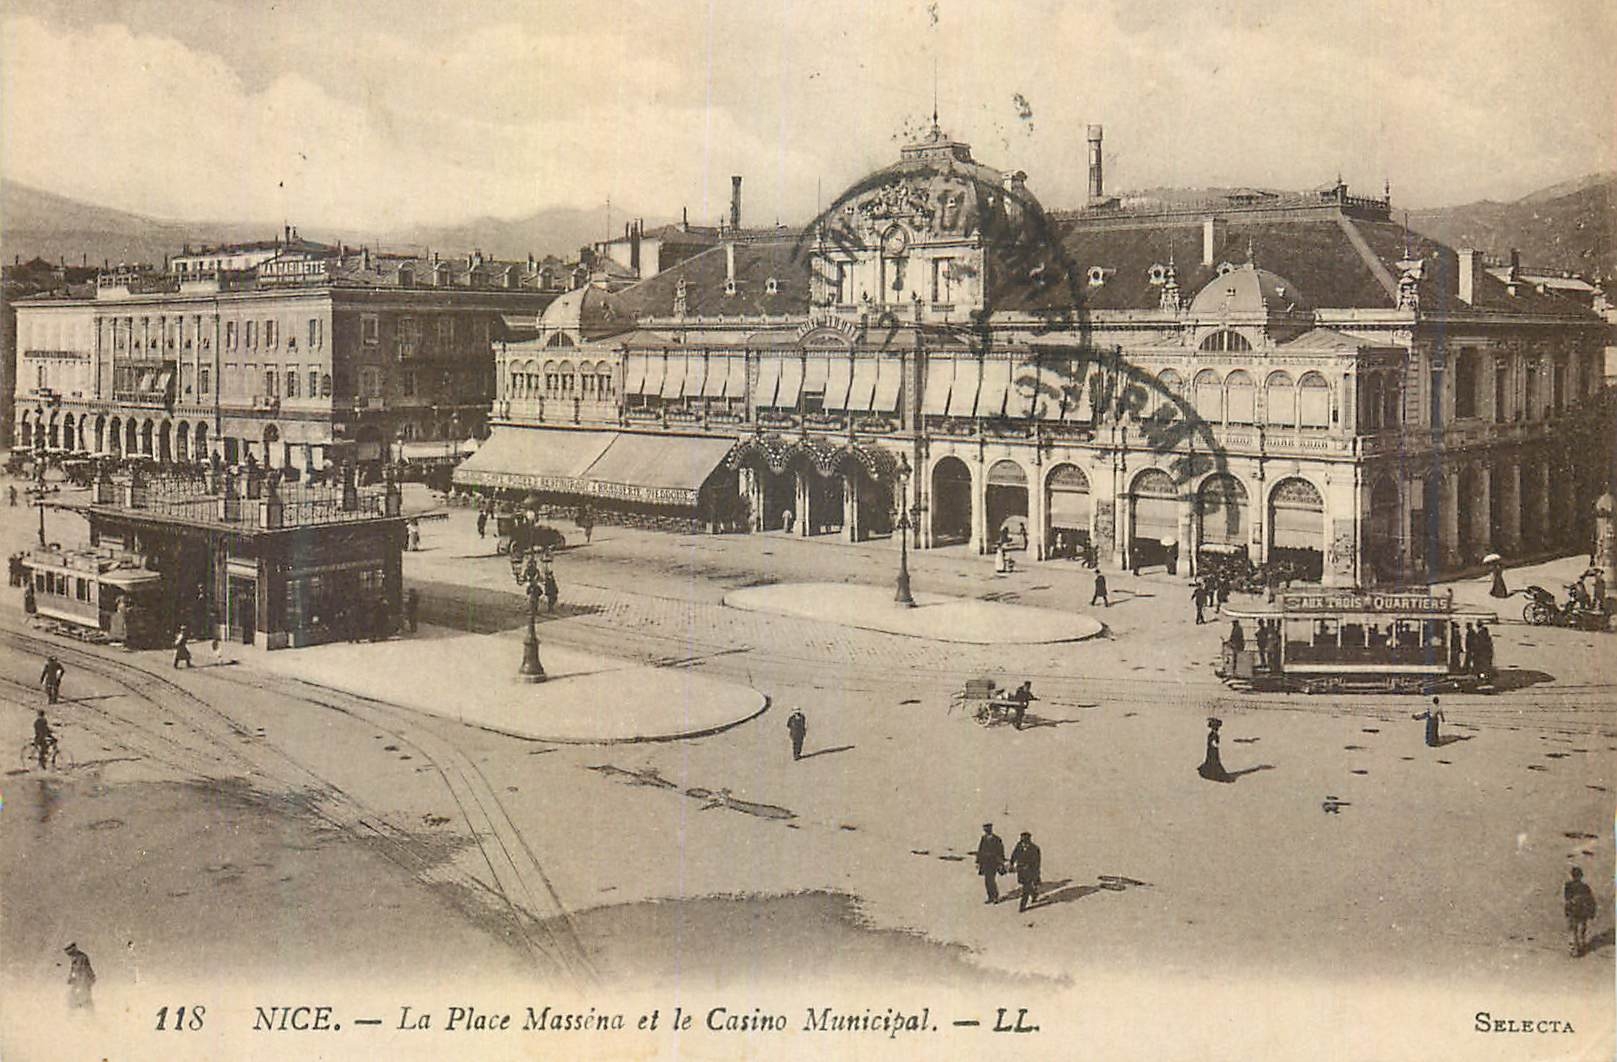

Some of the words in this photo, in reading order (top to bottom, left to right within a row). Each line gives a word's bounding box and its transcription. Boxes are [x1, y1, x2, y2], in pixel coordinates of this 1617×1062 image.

[1301, 596, 1323, 609] AUX
[1327, 596, 1362, 609] TROIS
[1373, 596, 1448, 610] QUARTIERS
